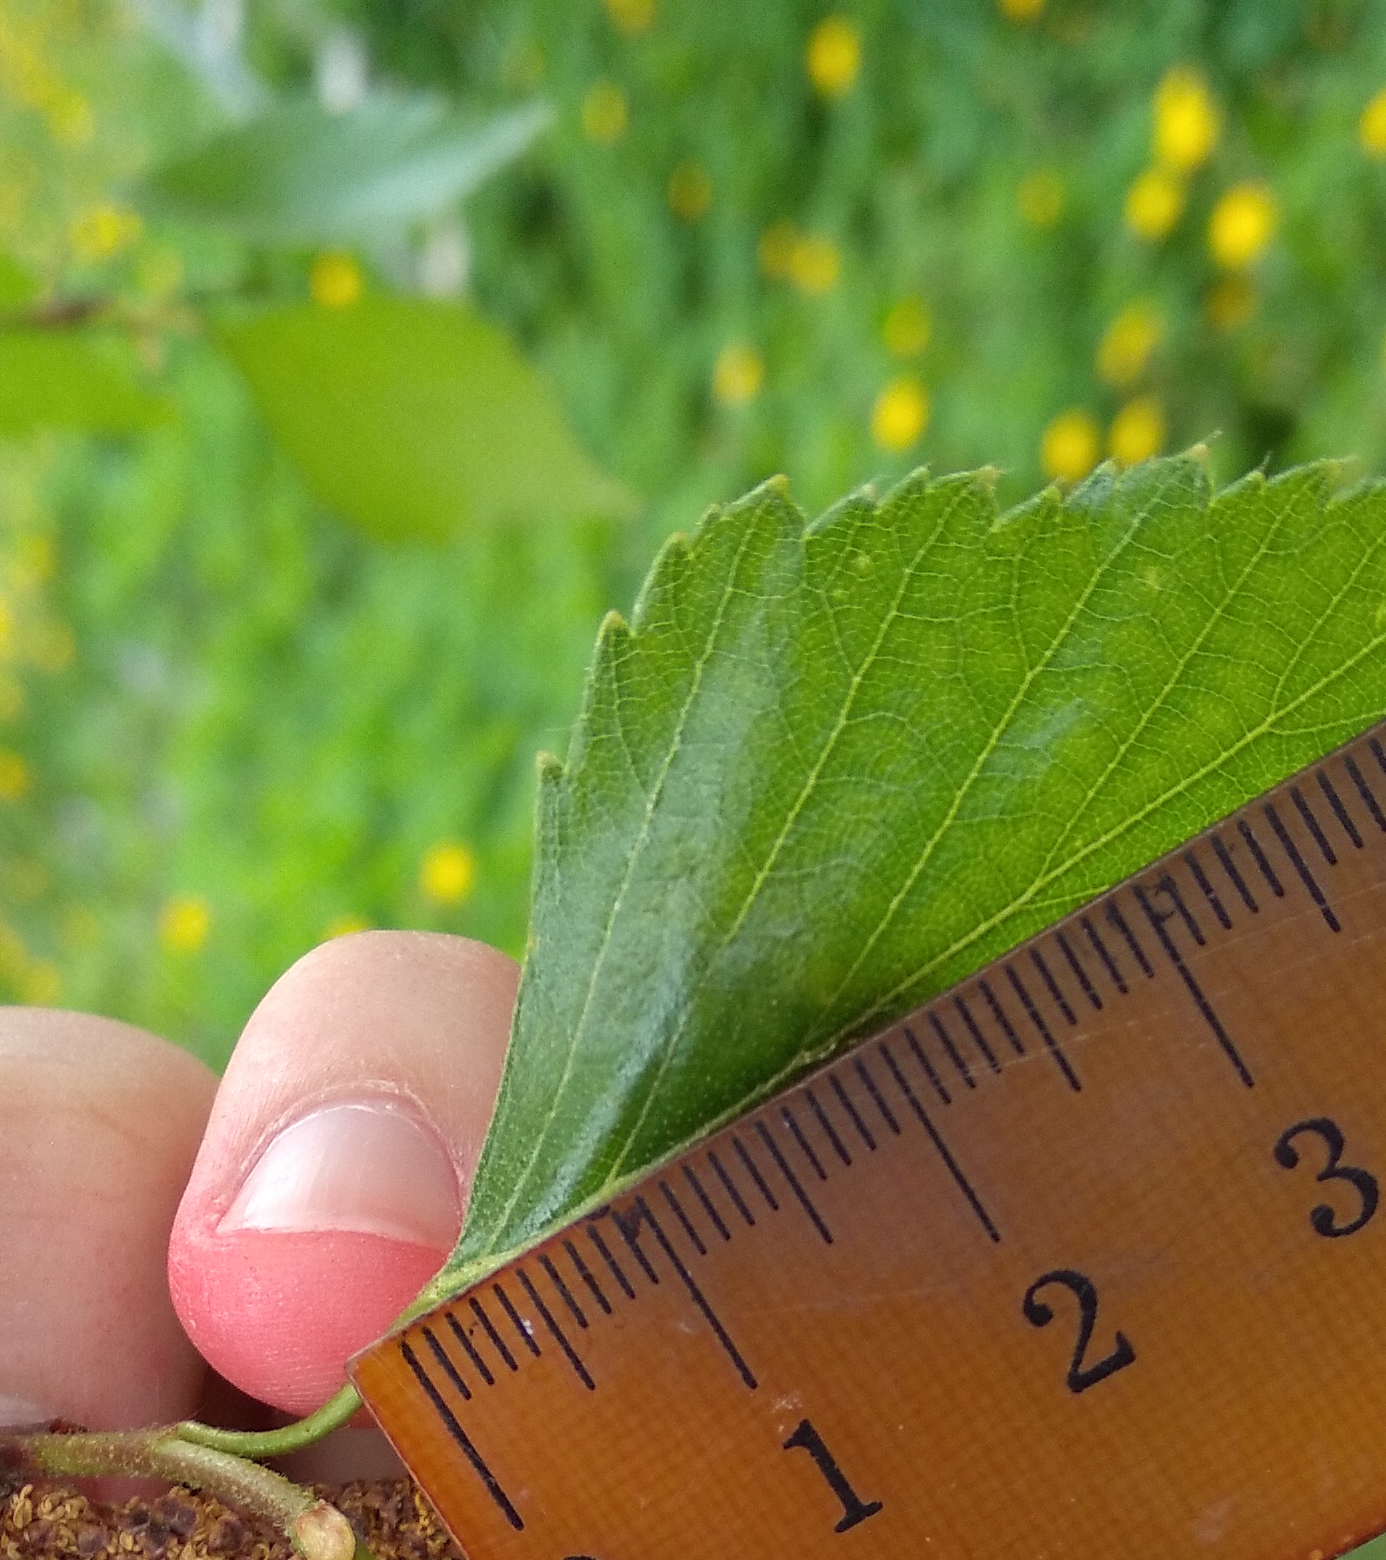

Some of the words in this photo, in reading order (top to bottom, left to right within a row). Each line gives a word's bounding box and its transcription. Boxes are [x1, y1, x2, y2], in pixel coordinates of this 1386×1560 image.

[783, 1419, 882, 1532] 1
[1023, 1269, 1135, 1392] 2
[1274, 1118, 1379, 1237] 3
